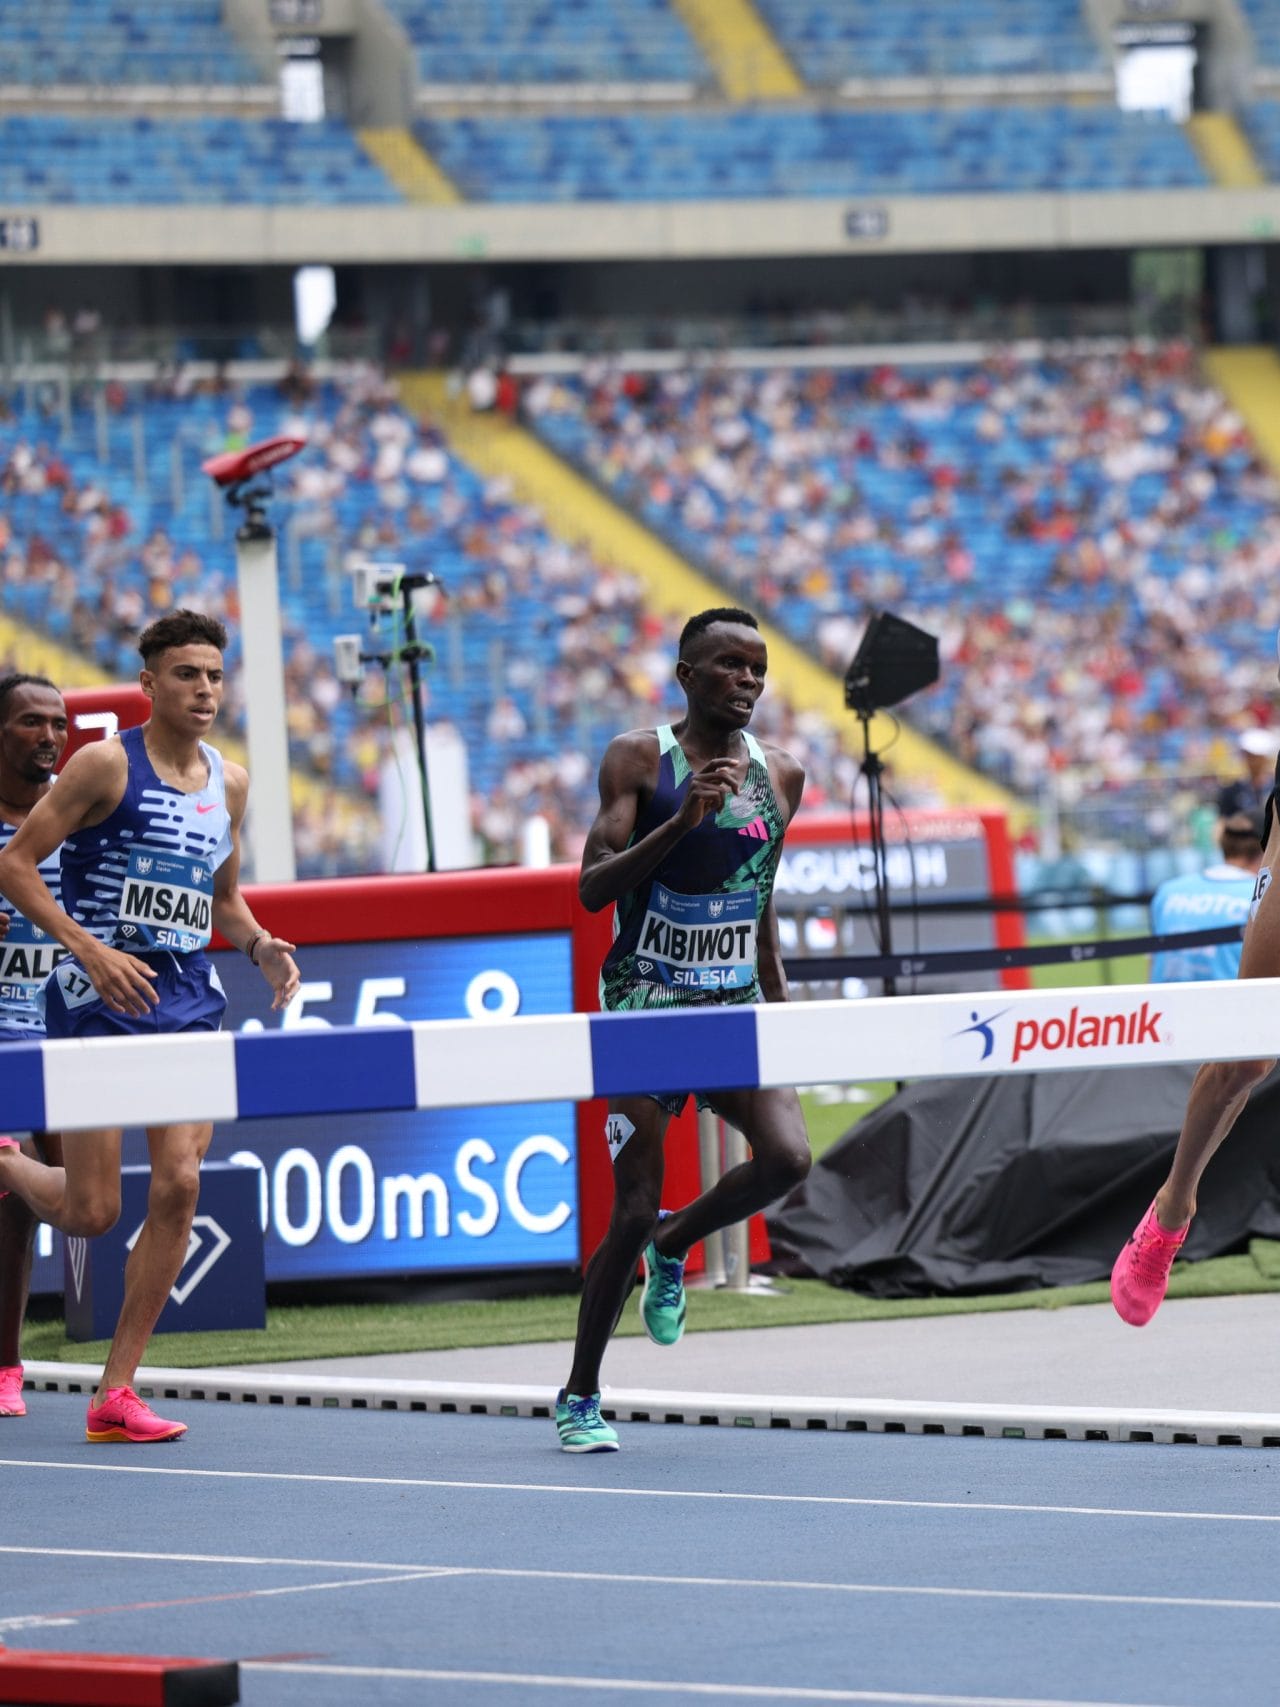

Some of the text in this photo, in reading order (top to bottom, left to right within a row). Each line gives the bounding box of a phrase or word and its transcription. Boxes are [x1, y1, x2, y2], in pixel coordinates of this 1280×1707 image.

[125, 883, 210, 931] MSAAD
[156, 929, 202, 951] SILESIA
[642, 916, 752, 962] KIBIWOT
[64, 971, 92, 998] 17
[672, 969, 738, 986] SILESIA
[1011, 1001, 1163, 1064] polanik
[608, 1120, 623, 1145] 14
